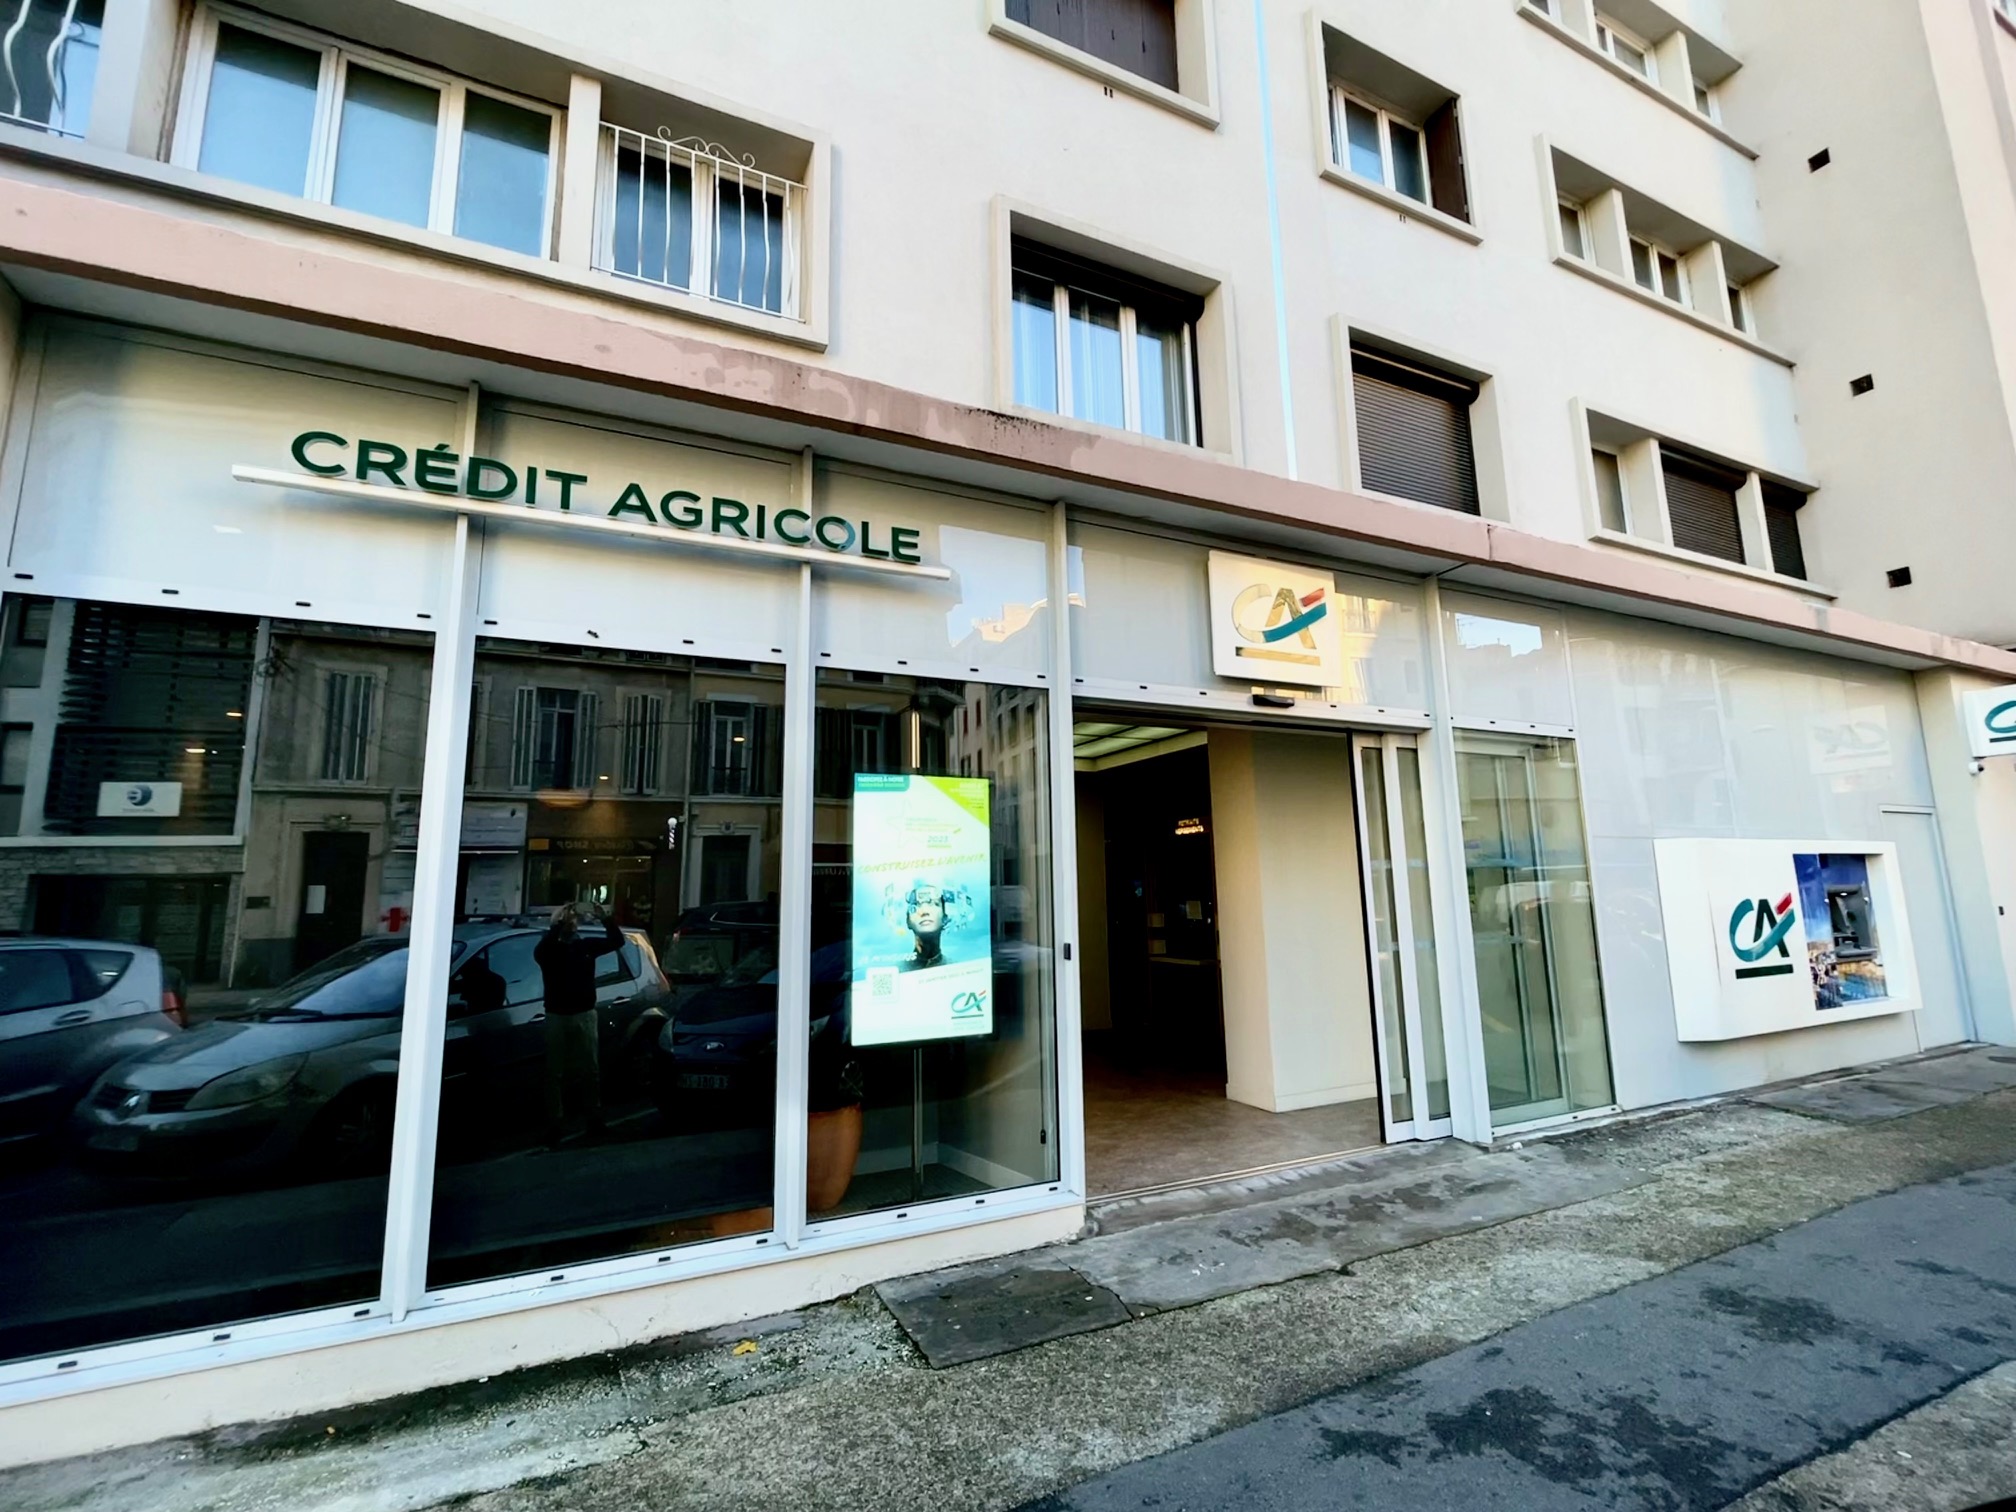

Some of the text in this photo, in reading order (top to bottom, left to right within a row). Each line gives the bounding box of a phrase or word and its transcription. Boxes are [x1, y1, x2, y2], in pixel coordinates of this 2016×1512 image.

[291, 431, 920, 564] CRÉDIT AGRICOLE
[857, 858, 935, 874] CONSTRUISEZ
